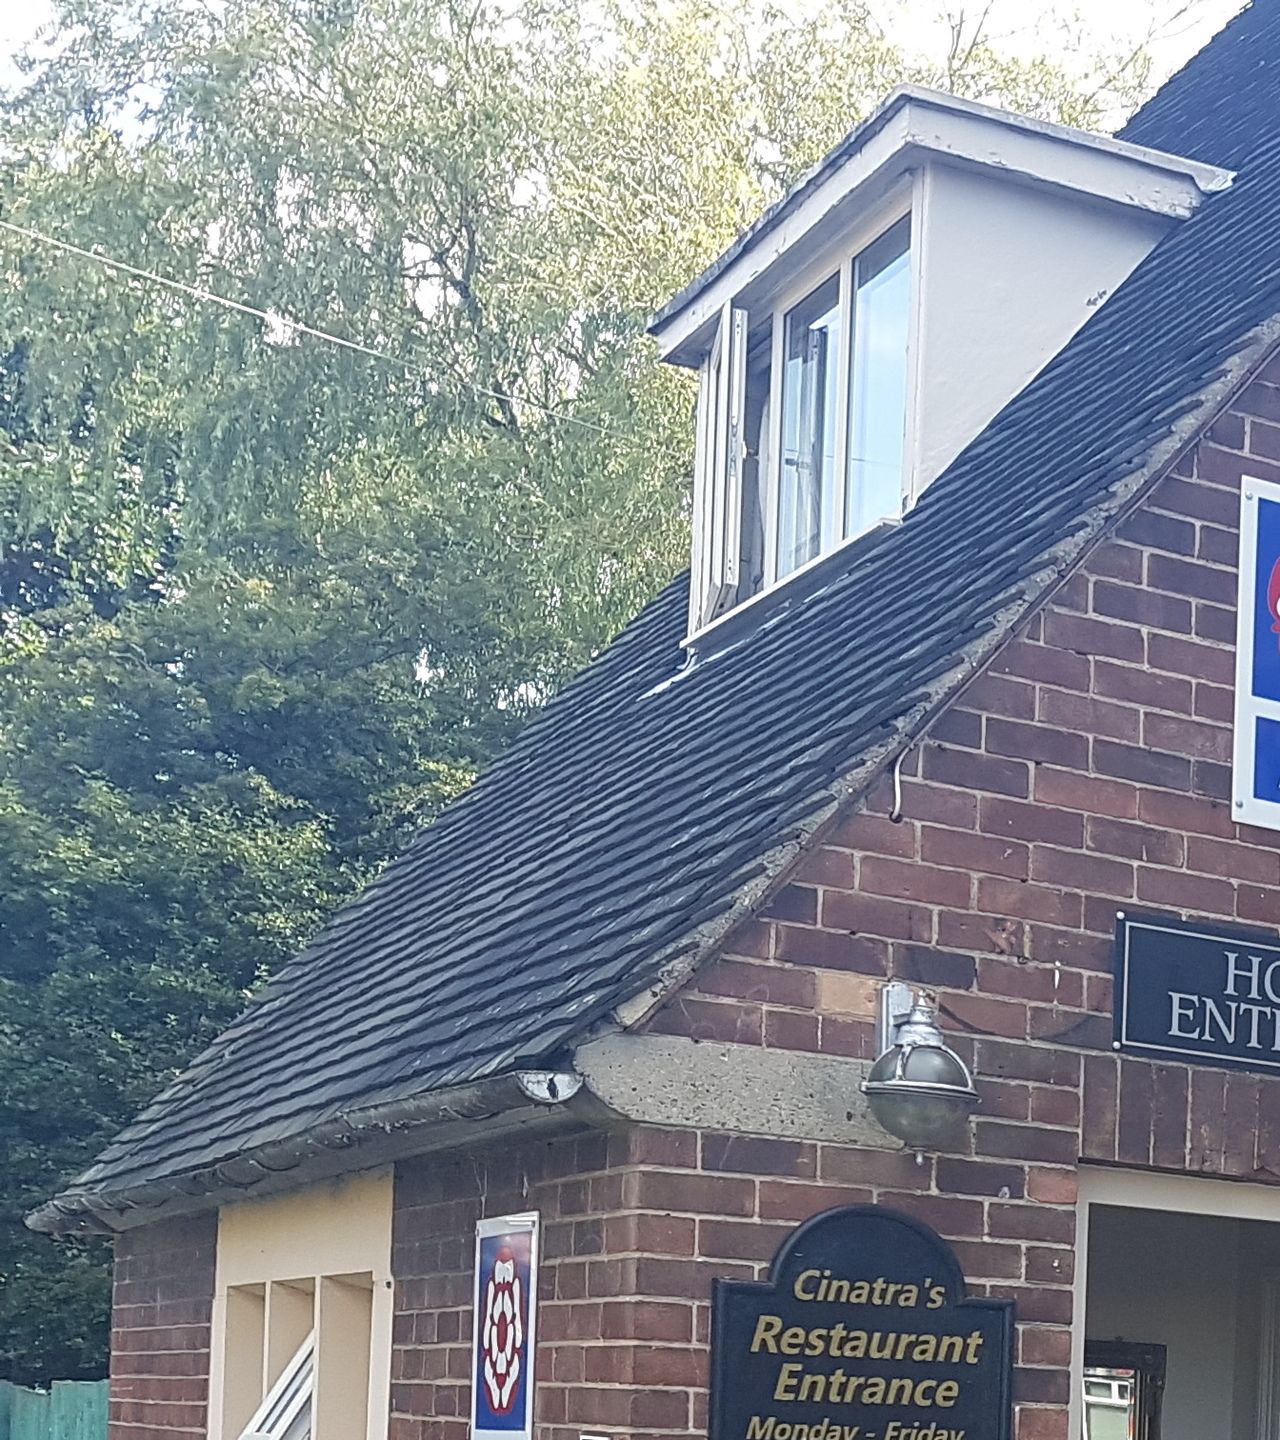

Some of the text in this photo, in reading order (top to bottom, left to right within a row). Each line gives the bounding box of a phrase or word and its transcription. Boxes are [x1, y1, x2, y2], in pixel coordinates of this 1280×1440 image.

[793, 1269, 946, 1309] Cinatra's
[750, 1315, 984, 1364] Restaurant
[773, 1363, 960, 1408] Entrance
